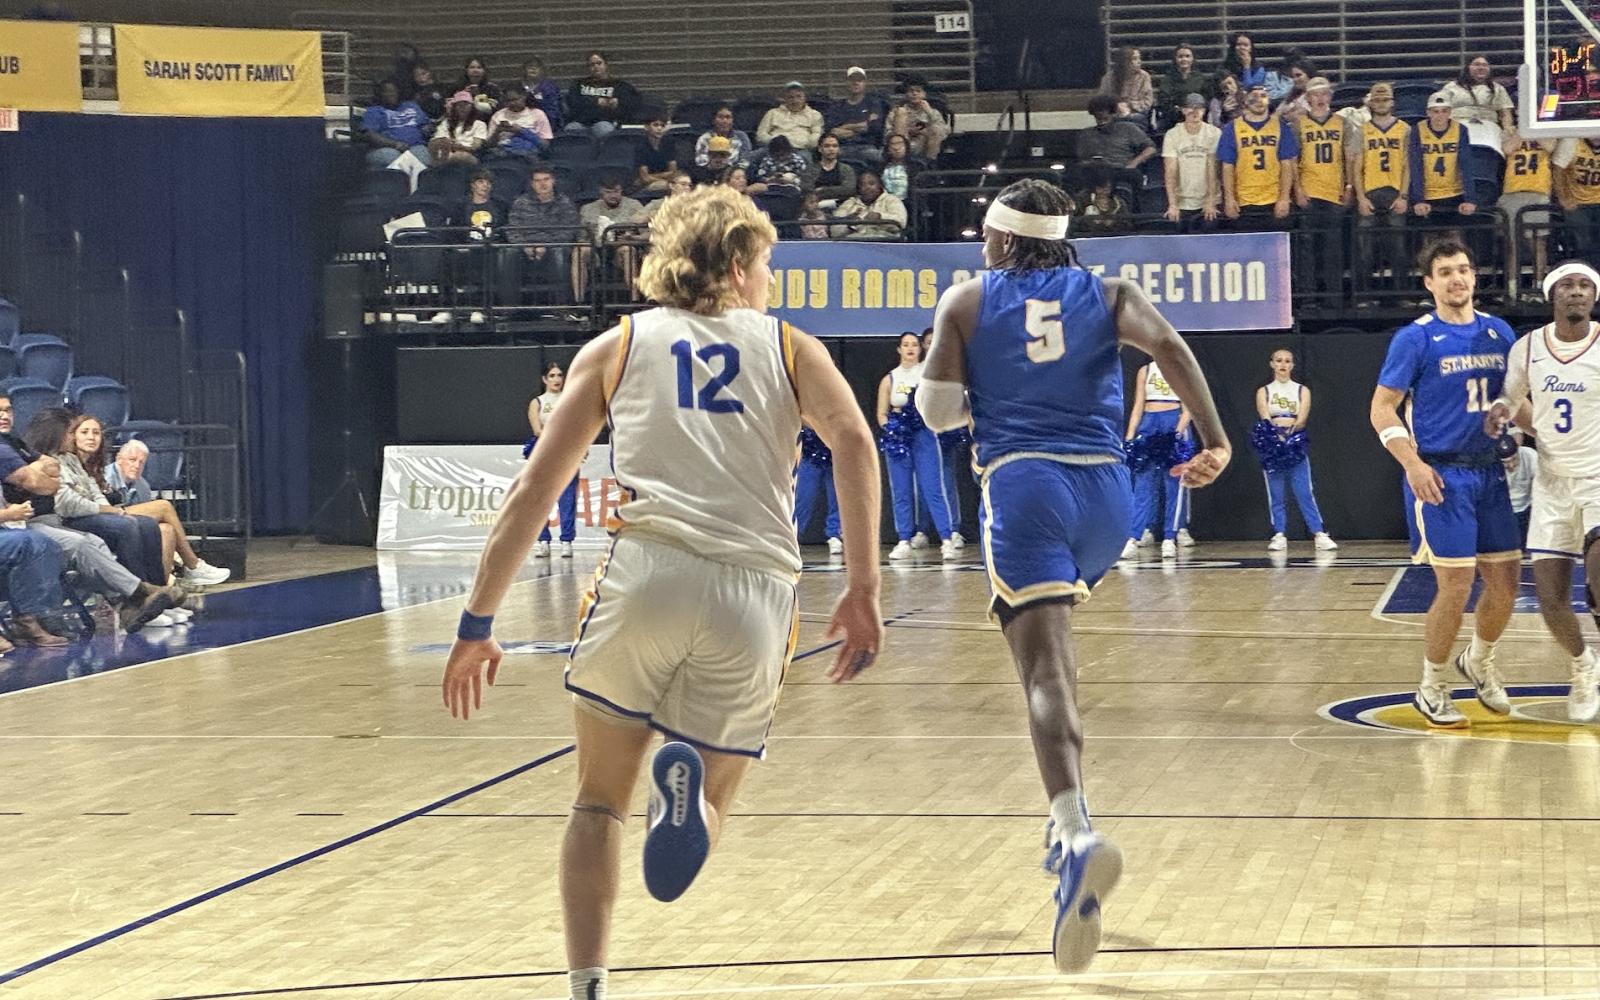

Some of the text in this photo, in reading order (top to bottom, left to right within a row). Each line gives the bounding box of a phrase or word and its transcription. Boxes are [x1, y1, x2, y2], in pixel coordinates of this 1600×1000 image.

[938, 16, 966, 30] 114
[144, 60, 295, 82] SARAH SCOTT FAMILY
[1241, 135, 1277, 148] RAMS
[1306, 130, 1340, 142] RAMS
[1368, 138, 1399, 150] RAMS
[1253, 149, 1265, 170] 3
[1315, 143, 1333, 164] 10
[1380, 151, 1391, 172] 2
[1433, 156, 1446, 177] 4
[1514, 153, 1538, 176] 24
[842, 268, 937, 309] RAMS
[1025, 299, 1064, 362] 5
[670, 339, 744, 414] 12
[1542, 375, 1586, 393] Rams
[1466, 377, 1493, 413] 11
[1554, 398, 1573, 434] 3
